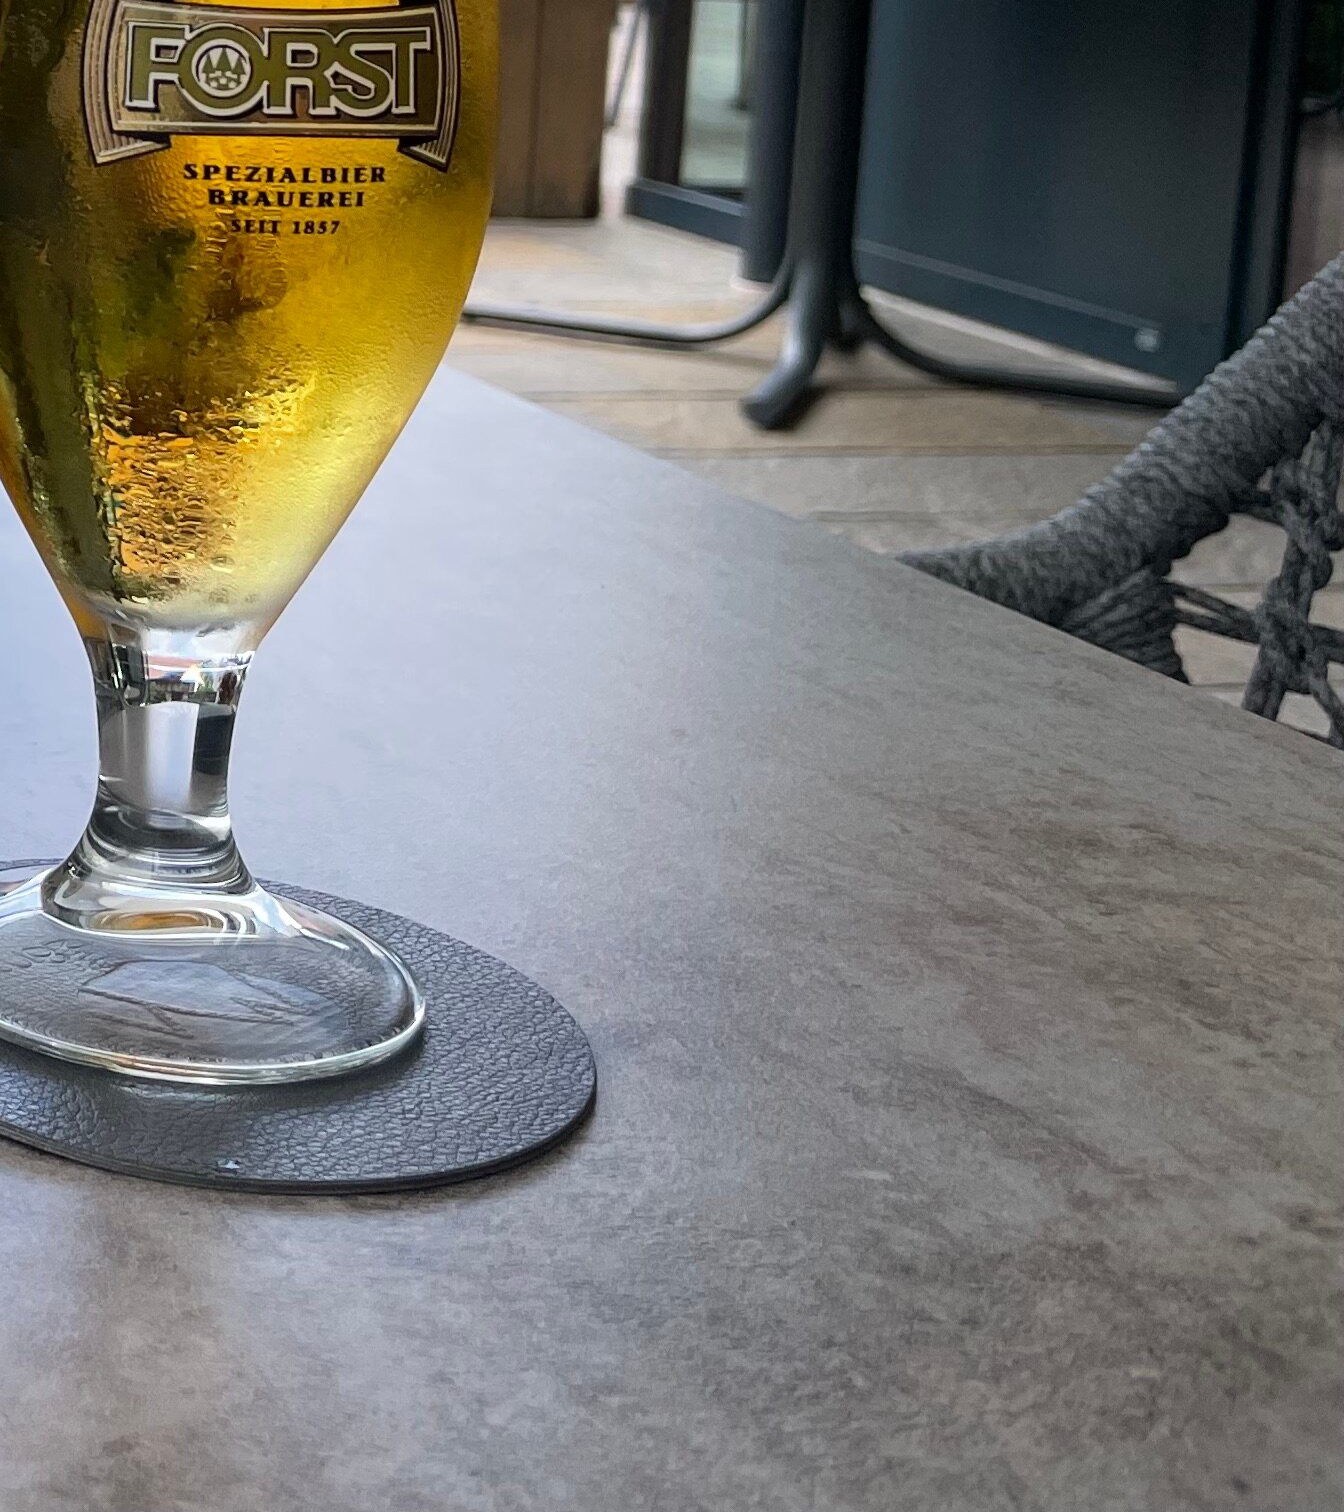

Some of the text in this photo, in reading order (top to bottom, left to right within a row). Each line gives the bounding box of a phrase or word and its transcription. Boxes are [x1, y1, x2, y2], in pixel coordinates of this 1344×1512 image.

[124, 20, 431, 118] FORST
[183, 164, 386, 183] SPEZIALBIER
[208, 189, 365, 208] BRAUEREI
[230, 219, 340, 235] SEIT 1857
